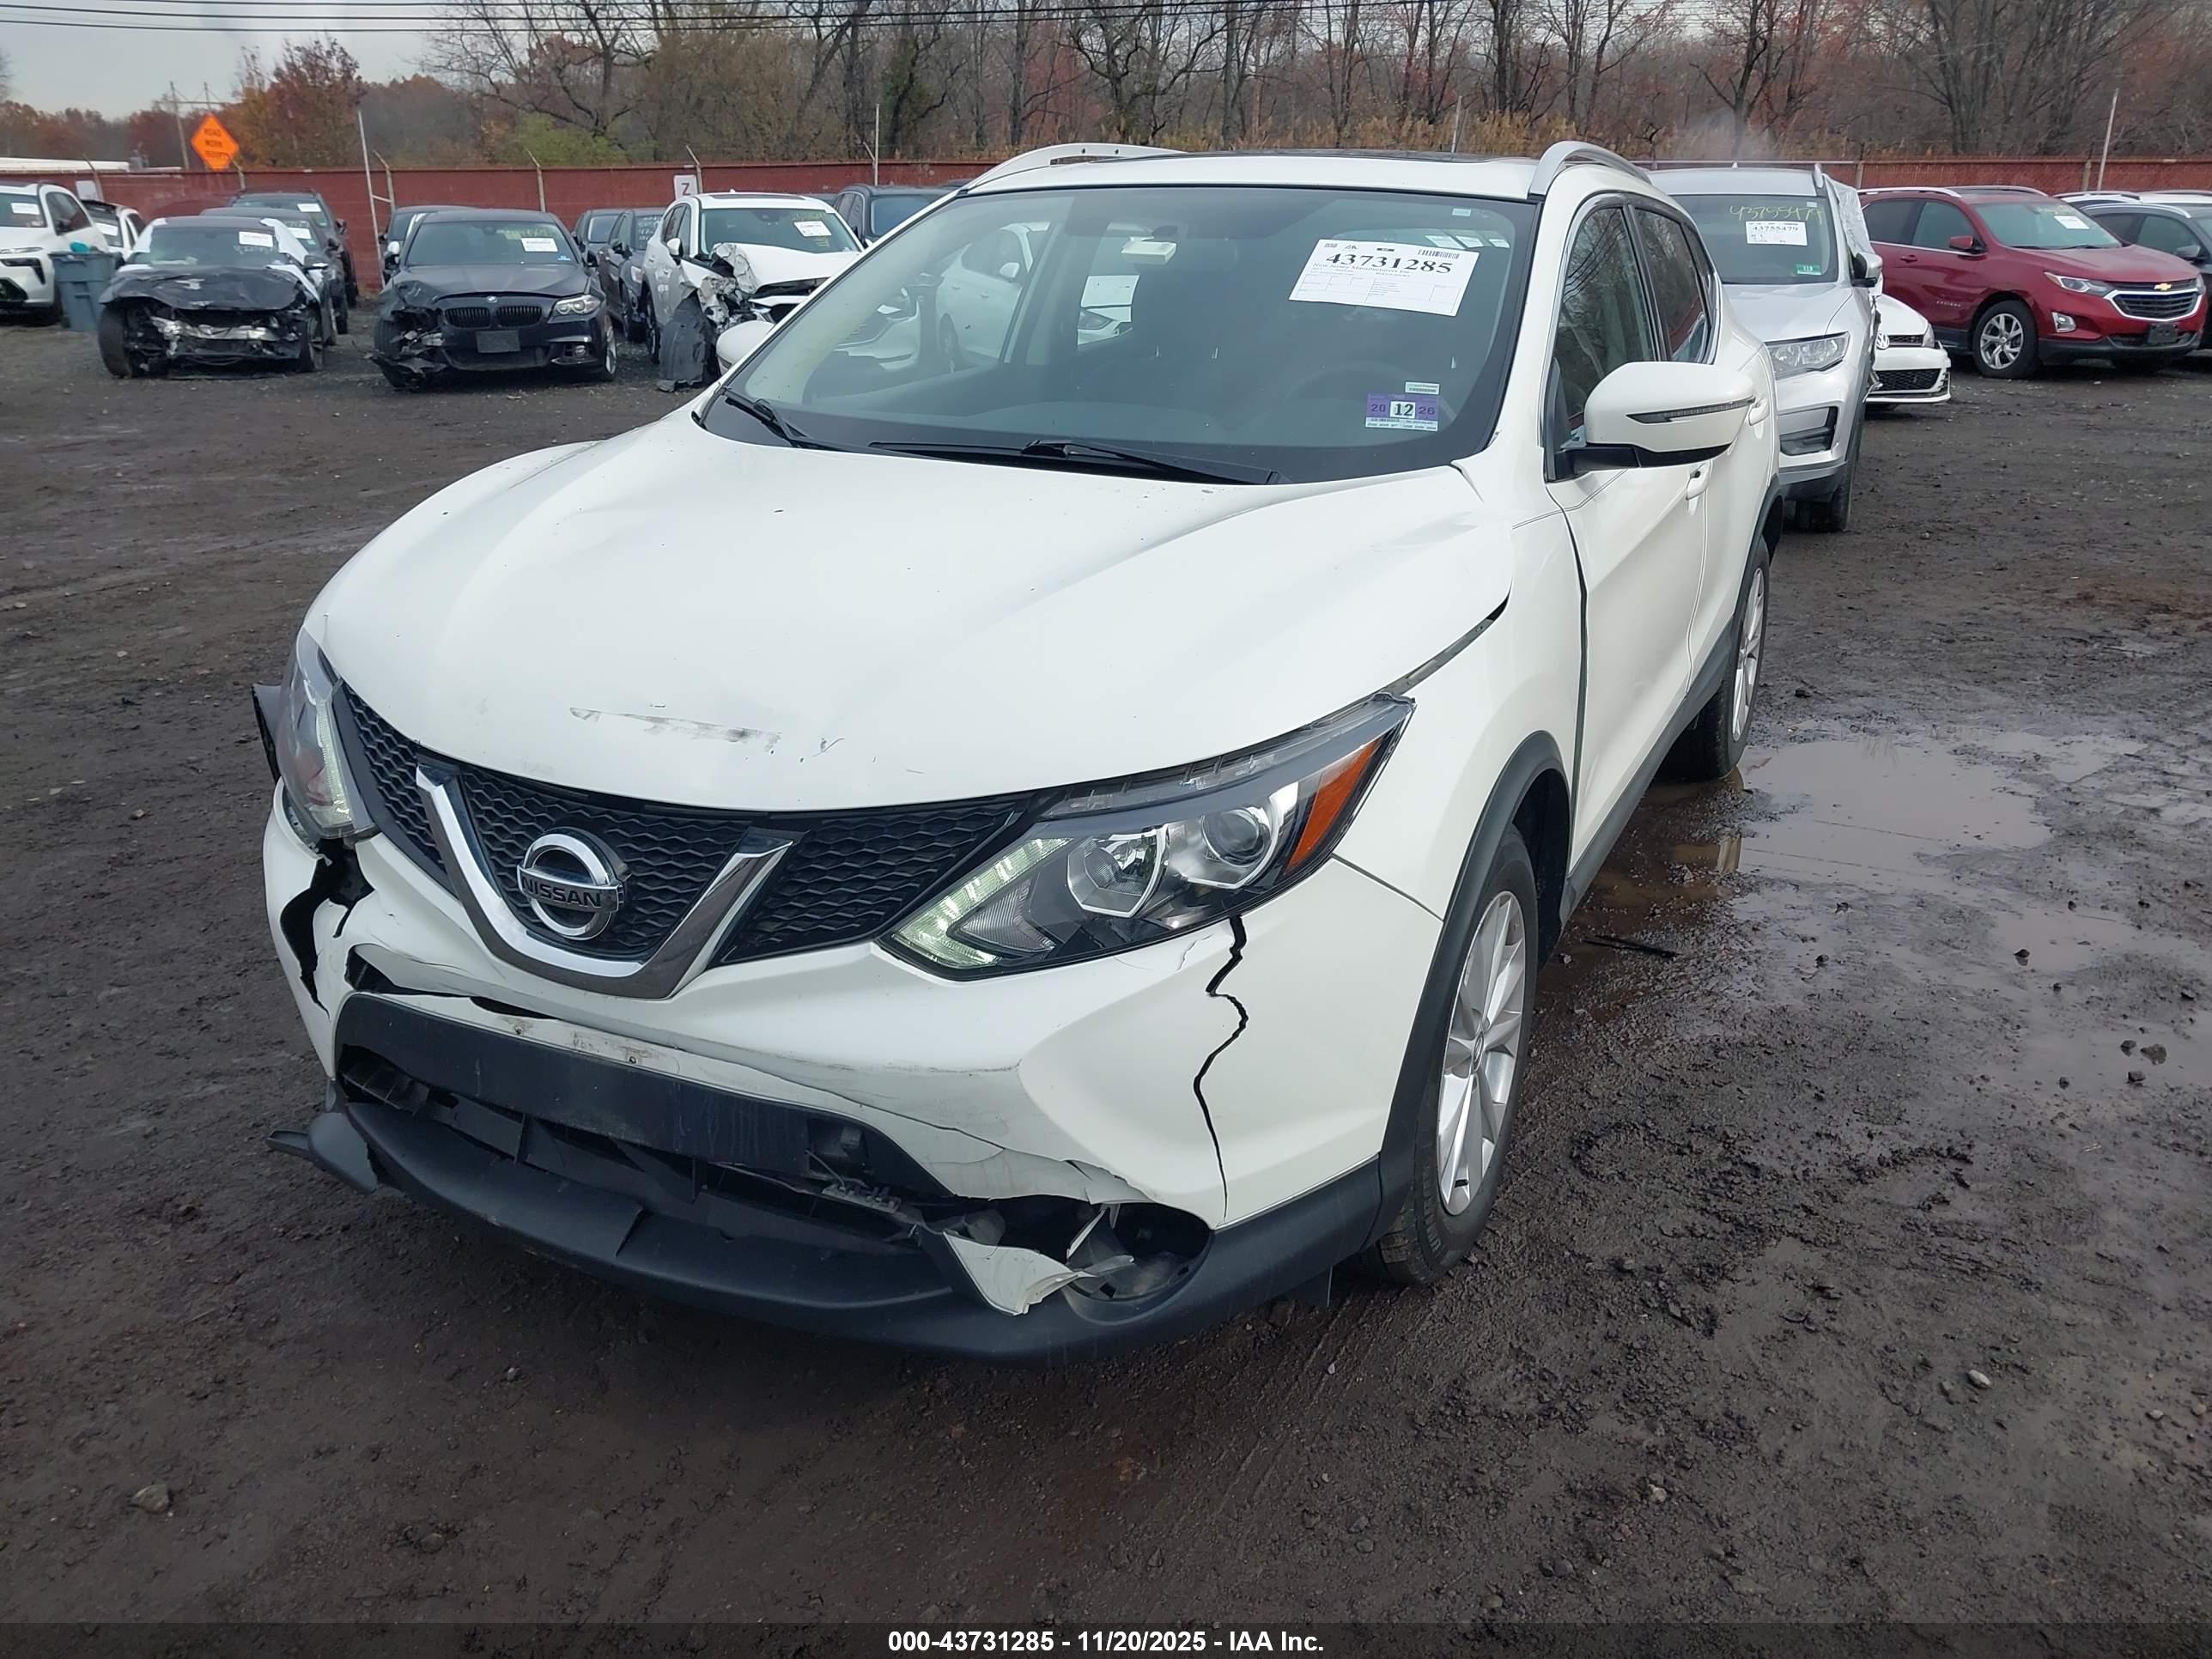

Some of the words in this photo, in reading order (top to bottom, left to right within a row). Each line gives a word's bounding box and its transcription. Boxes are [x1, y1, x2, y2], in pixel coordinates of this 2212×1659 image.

[681, 182, 691, 196] Z
[1326, 252, 1453, 274] 43731285
[1394, 403, 1414, 416] 12
[522, 877, 601, 908] NISSAN
